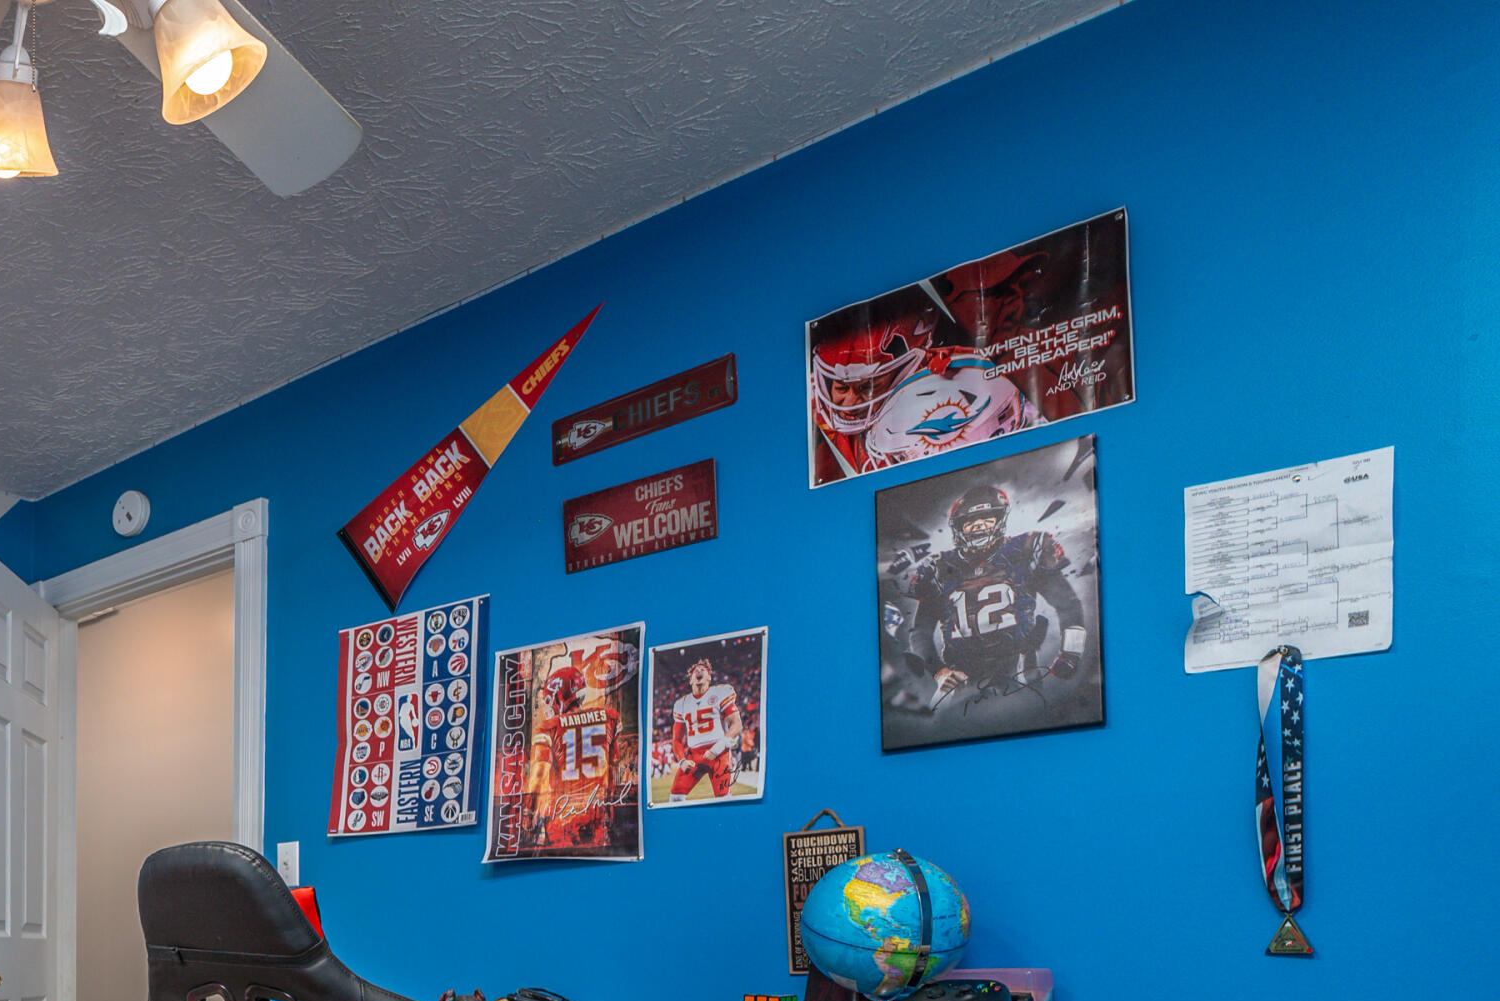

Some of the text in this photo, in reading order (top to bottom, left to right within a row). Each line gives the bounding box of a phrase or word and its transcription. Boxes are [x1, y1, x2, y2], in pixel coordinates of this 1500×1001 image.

[1035, 320, 1069, 340] IT'S
[1070, 305, 1123, 330] GRIM,
[1014, 329, 1079, 360] BE THE
[521, 338, 571, 396] CHIEFS
[983, 358, 1026, 380] GRIM
[1045, 379, 1077, 397] ANDY
[1081, 372, 1107, 386] REID
[612, 380, 701, 432] CHIEFS
[363, 440, 473, 564] BACK BACK
[369, 447, 443, 531] SUPER BOWL
[634, 474, 684, 502] CHIEFS
[386, 472, 463, 557] CHAMPIONS
[644, 497, 677, 517] Fans
[612, 500, 712, 549] WELCOME
[396, 547, 412, 566] LVII
[568, 526, 716, 572] OTHERS NOT ALLOWED
[949, 582, 1018, 640] 12
[394, 616, 418, 687] WESTERN
[452, 637, 465, 650] 76
[376, 670, 390, 689] NW
[431, 659, 438, 678] A
[559, 709, 607, 728] MAHOMES
[684, 706, 715, 738] 15
[379, 741, 385, 758] P
[400, 738, 411, 749] NBA
[430, 732, 437, 750] C
[561, 724, 608, 782] 15
[495, 655, 526, 857] KANSAS CITY
[396, 759, 421, 825] EASTERN
[371, 810, 385, 828] SW
[424, 805, 434, 823] SE
[1284, 759, 1302, 873] FIRST PLACE
[790, 832, 856, 849] TOUCHDOWN
[797, 844, 849, 856] GRIDIRON
[791, 850, 799, 883] SACK
[798, 856, 823, 869] FIELD
